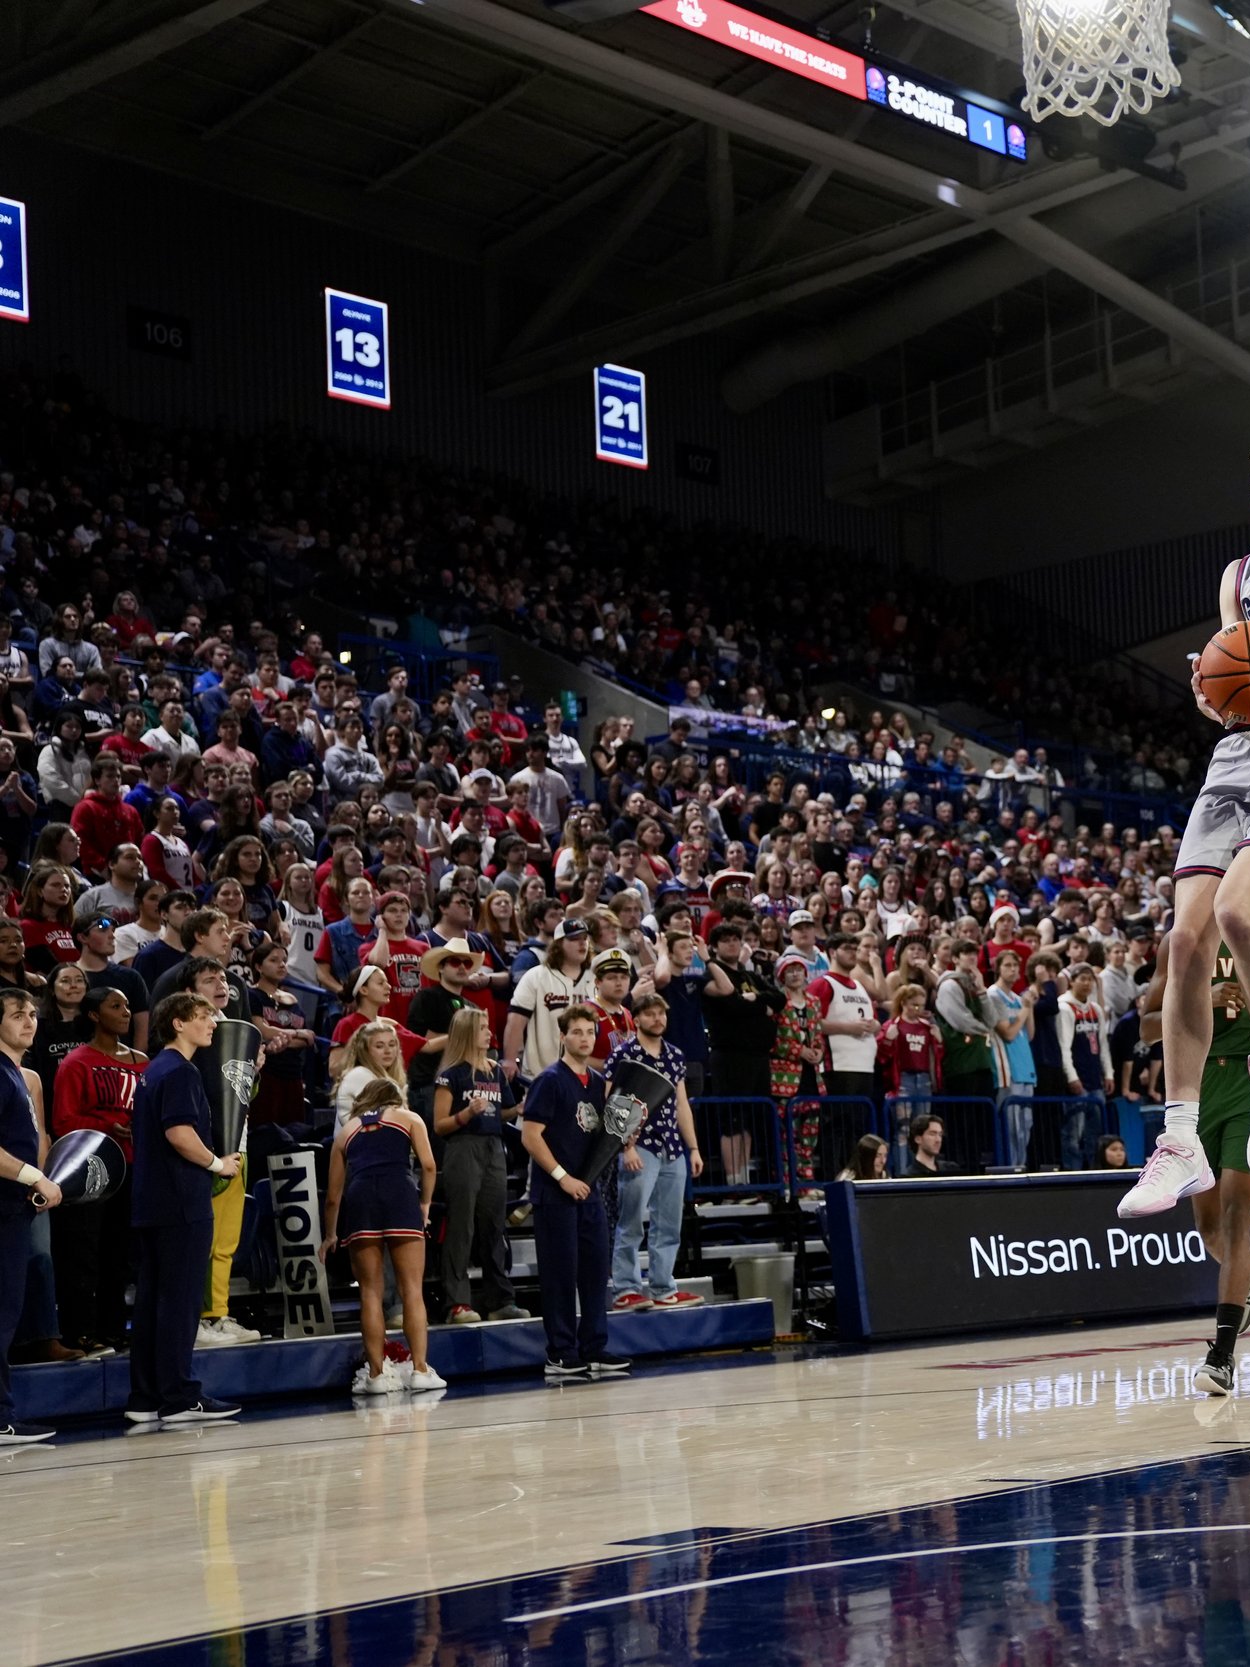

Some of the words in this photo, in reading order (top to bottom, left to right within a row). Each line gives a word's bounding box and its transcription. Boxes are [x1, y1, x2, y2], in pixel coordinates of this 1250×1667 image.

[888, 92, 967, 137] COUNTER
[983, 120, 993, 141] 1
[145, 321, 184, 349] 106
[335, 327, 381, 368] 13
[602, 395, 640, 433] 21
[304, 932, 314, 952] 0
[271, 1166, 326, 1325] NOISE
[969, 1234, 1101, 1279] Nissan.
